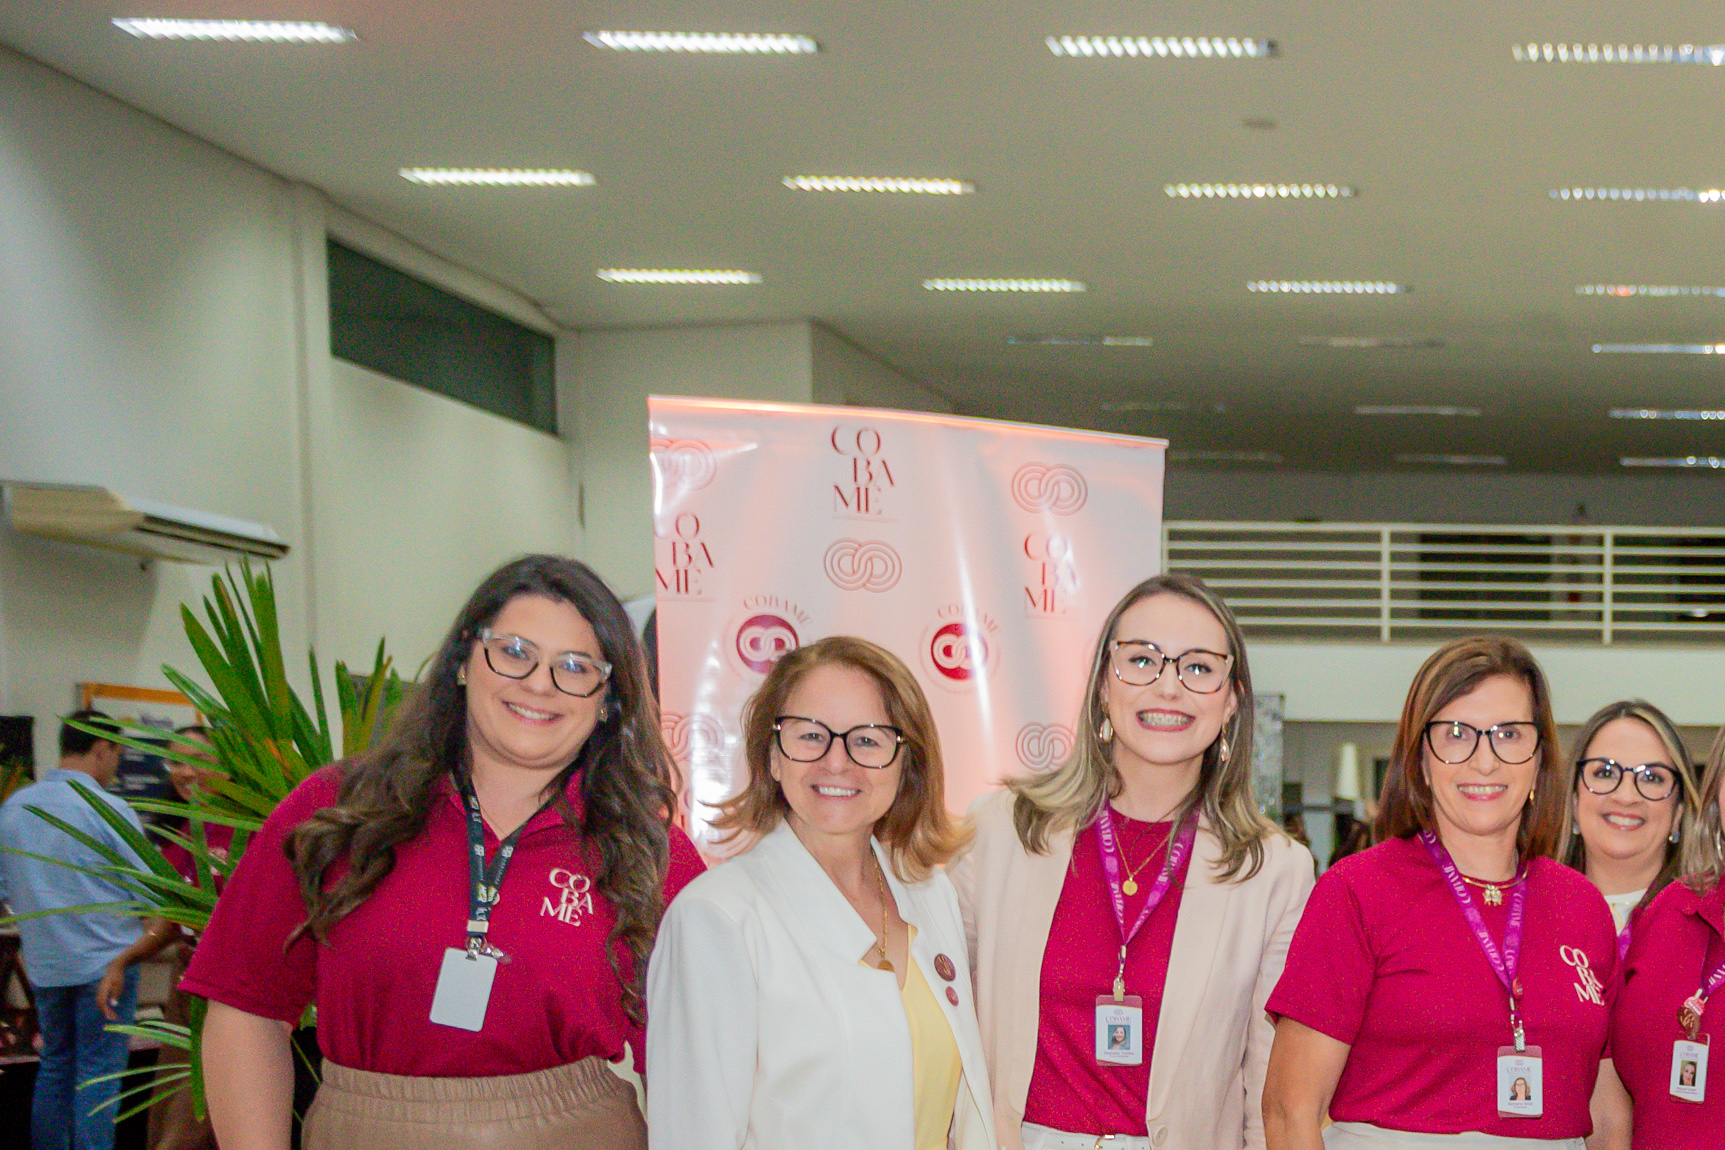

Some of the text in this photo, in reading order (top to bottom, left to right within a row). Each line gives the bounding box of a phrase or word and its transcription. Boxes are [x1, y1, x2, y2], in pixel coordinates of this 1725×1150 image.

[830, 424, 882, 457] CO
[853, 457, 895, 487] BA
[833, 483, 883, 516] ME
[672, 540, 715, 568] BA
[548, 866, 591, 894] CO
[539, 896, 583, 927] ME
[560, 887, 595, 915] BA
[1559, 944, 1589, 969] CO
